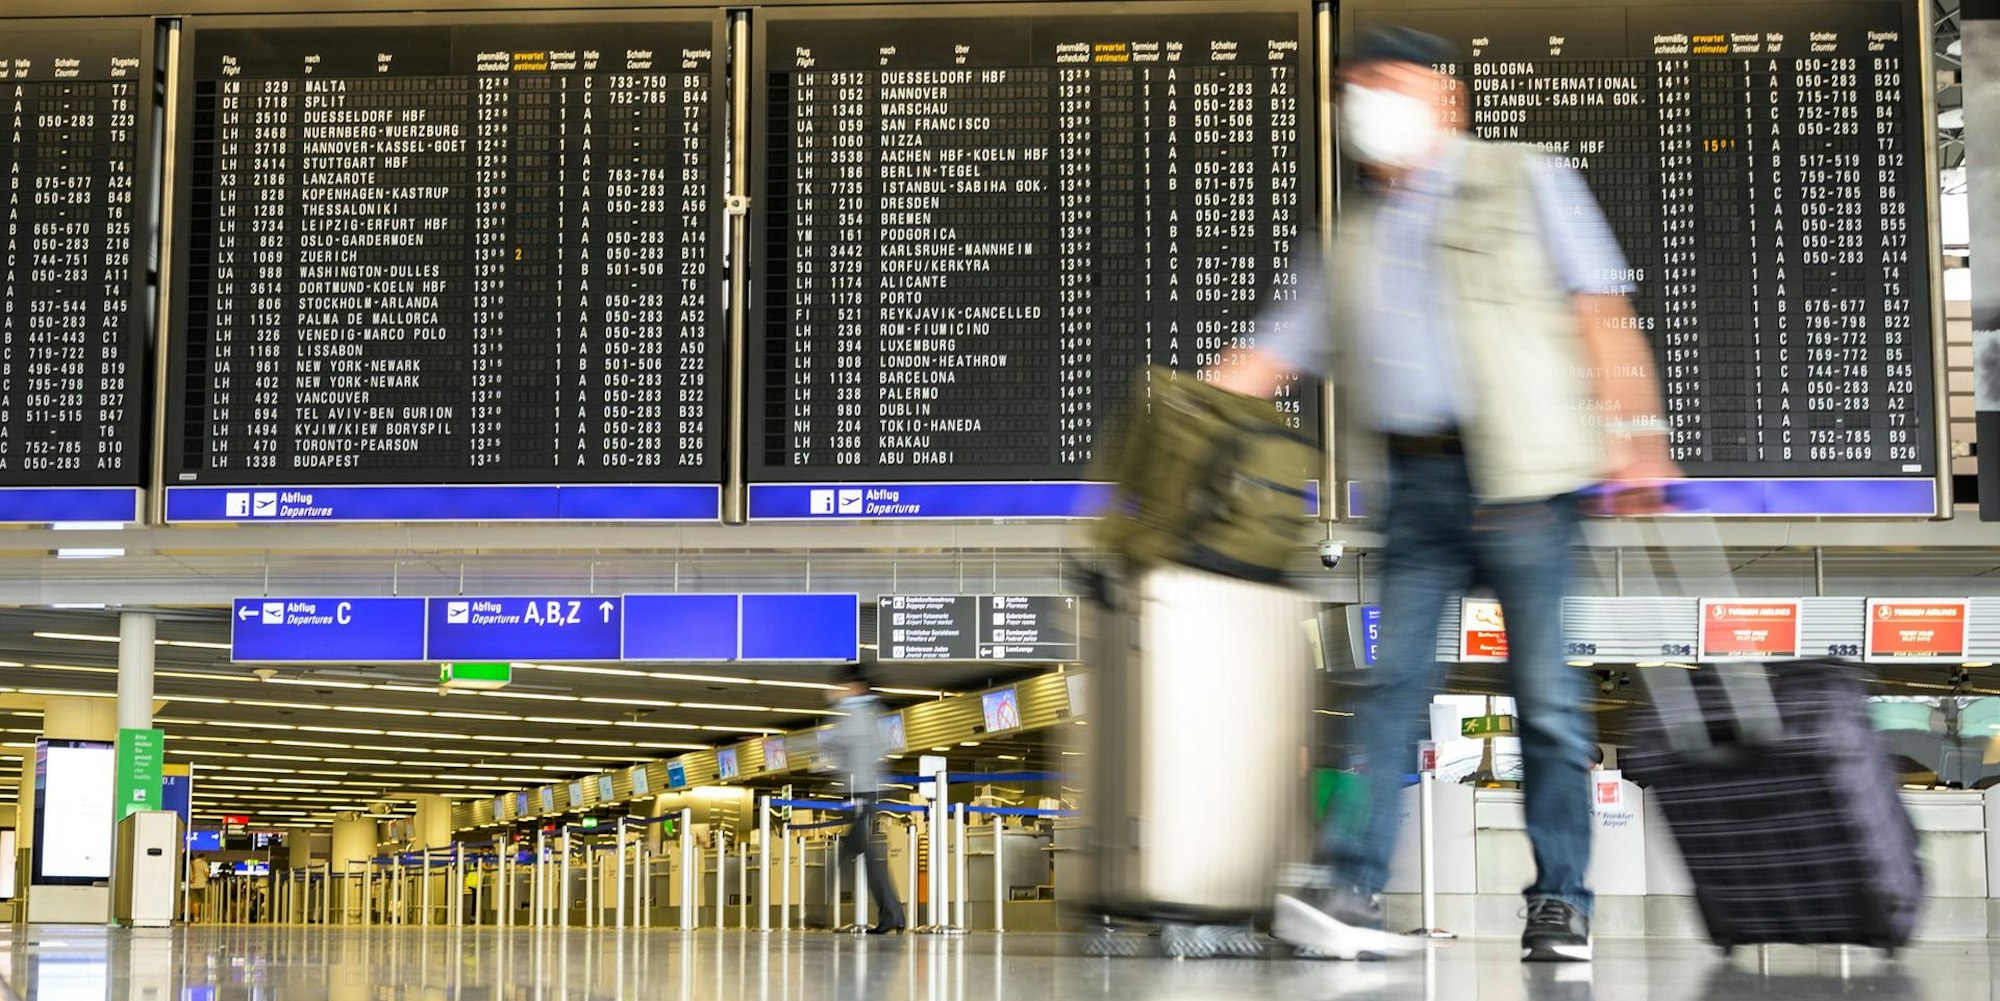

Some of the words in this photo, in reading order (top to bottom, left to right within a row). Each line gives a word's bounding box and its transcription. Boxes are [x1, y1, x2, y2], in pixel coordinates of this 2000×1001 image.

[1472, 37, 1489, 47] nach
[1549, 36, 1565, 46] über
[1692, 34, 1725, 43] erwartet
[550, 51, 576, 60] Terminal
[584, 50, 600, 59] Halle
[626, 50, 653, 60] Schalter
[682, 49, 712, 60] Flugsteig
[1473, 48, 1482, 57] to
[1550, 48, 1561, 56] via
[1692, 44, 1729, 54] estimated
[54, 58, 80, 68] Schalter
[110, 57, 140, 68] Flugsteig
[222, 56, 236, 65] Flug
[304, 54, 320, 63] nach
[378, 52, 392, 62] über
[476, 52, 510, 62] planmäßig
[514, 52, 544, 61] erwartet
[222, 66, 241, 75] Flight
[304, 66, 312, 74] to
[378, 64, 389, 72] via
[476, 62, 510, 71] scheduled
[514, 62, 548, 70] estimated
[550, 60, 577, 70] Terminal
[584, 60, 597, 69] Hall
[626, 60, 652, 69] Counter
[682, 59, 698, 69] Gate
[1473, 62, 1534, 76] BOLOGNA
[54, 68, 80, 78] Counter
[110, 68, 126, 77] Gate
[881, 70, 973, 85] DUESSELDORF
[981, 70, 1006, 84] HBF
[305, 79, 346, 93] MALTA
[609, 75, 667, 89] 733-750
[683, 75, 700, 88] B5
[1474, 76, 1638, 92] DUBAI-INTERNATIONAL
[881, 86, 948, 100] HANNOVER
[304, 95, 345, 109] SPLIT
[1476, 92, 1604, 108] ISTANBUL-SABIHA
[880, 102, 948, 116] WARSCHAU
[304, 109, 393, 124] DUESSELDORF
[402, 109, 426, 122] HBF
[1475, 110, 1526, 123] RHODOS
[881, 118, 906, 132] SAN
[914, 117, 990, 131] FRANCISCO
[303, 124, 459, 139] NUERNBERG-WUERZBURG
[1475, 125, 1519, 139] TURIN
[303, 139, 467, 154] HANNOVER-KASSEL-GOET
[880, 133, 923, 147] NIZZA
[1579, 140, 1605, 152] HBF
[880, 149, 931, 163] AACHEN
[939, 148, 1016, 162] HBF-KOELN
[1024, 147, 1049, 161] HBF
[1799, 154, 1860, 167] 517-519
[1878, 153, 1903, 167] B12
[303, 156, 376, 170] STUTTGART
[384, 156, 408, 169] HBF
[880, 164, 981, 178] BERLIN-TEGEL
[35, 176, 92, 189] 675-677
[108, 176, 132, 188] A24
[303, 172, 375, 185] LANZAROTE
[1195, 177, 1254, 191] 671-675
[1272, 177, 1296, 190] B47
[302, 186, 449, 201] KOPENHAGEN-KASTRUP
[882, 180, 1007, 194] ISTANBUL-SABIHA
[302, 203, 398, 216] THESSALONIKI
[880, 196, 940, 210] DRESDEN
[301, 218, 415, 232] LEIPZIG-ERFURT
[424, 217, 448, 230] HBF
[881, 212, 931, 225] BREMEN
[33, 223, 90, 236] 665-670
[106, 222, 130, 235] B25
[880, 227, 956, 241] PODGORICA
[300, 233, 424, 247] OSLO-GARDERMOEN
[880, 242, 1033, 257] KARLSRUHE-MANNHEIM
[300, 250, 357, 263] ZUERICH
[299, 264, 439, 278] WASHINGTON-DULLES
[880, 259, 990, 273] KORFU/KERKYRA
[299, 280, 414, 294] DORTMUND-KOELN
[422, 280, 446, 293] HBF
[880, 275, 947, 289] ALICANTE
[298, 296, 439, 310] STOCKHOLM-ARLANDA
[880, 291, 922, 304] PORTO
[1804, 299, 1865, 313] 676-677
[1884, 299, 1909, 312] B47
[298, 313, 339, 325] PALMA
[347, 312, 363, 325] DE
[372, 311, 438, 325] MALLORCA
[880, 306, 1041, 321] REYKJAVIK-CANCELLED
[297, 328, 405, 341] VENEDIG-MARCO
[413, 327, 446, 340] POLO
[879, 322, 990, 337] ROM-FIUMICINO
[297, 344, 363, 357] LISSABON
[880, 338, 956, 352] LUXEMBURG
[296, 360, 321, 373] NEW
[330, 359, 420, 373] YORK-NEWARK
[880, 354, 1007, 368] LONDON-HEATHROW
[879, 370, 955, 384] BARCELONA
[1807, 364, 1868, 378] 744-746
[1886, 364, 1912, 377] B45
[28, 378, 83, 391] 795-798
[101, 378, 124, 390] B28
[296, 376, 321, 389] NEW
[329, 375, 419, 388] YORK-NEWARK
[295, 391, 369, 404] VANCOUVER
[879, 386, 939, 400] PALERMO
[295, 407, 319, 420] TEL
[328, 407, 394, 420] AVIV-BEN
[402, 406, 453, 420] GURION
[879, 403, 930, 416] DUBLIN
[295, 423, 378, 436] KYJIW/KIEW
[386, 422, 451, 436] BORYSPIL
[879, 418, 982, 433] TOKIO-HANEDA
[25, 441, 81, 454] 752-785
[98, 440, 122, 453] B10
[295, 438, 419, 452] TORONTO-PEARSON
[879, 435, 930, 448] KRAKAU
[294, 454, 359, 468] BUDAPEST
[878, 451, 904, 465] ABU
[912, 451, 953, 464] DHABI
[280, 492, 313, 504] Abflug
[866, 490, 900, 502] Abflug
[280, 506, 333, 518] Departures
[866, 503, 920, 515] Departures
[286, 602, 316, 614] Abflug
[336, 602, 352, 625] C
[472, 602, 502, 614] Abflug
[524, 601, 581, 626] A,B,Z
[286, 614, 333, 625] Departures
[472, 614, 520, 624] Departures
[1566, 642, 1596, 654] 535
[1661, 644, 1691, 656] 534
[1828, 644, 1858, 656] 533
[1602, 812, 1634, 821] Frankfurt
[1602, 820, 1628, 828] Airport
